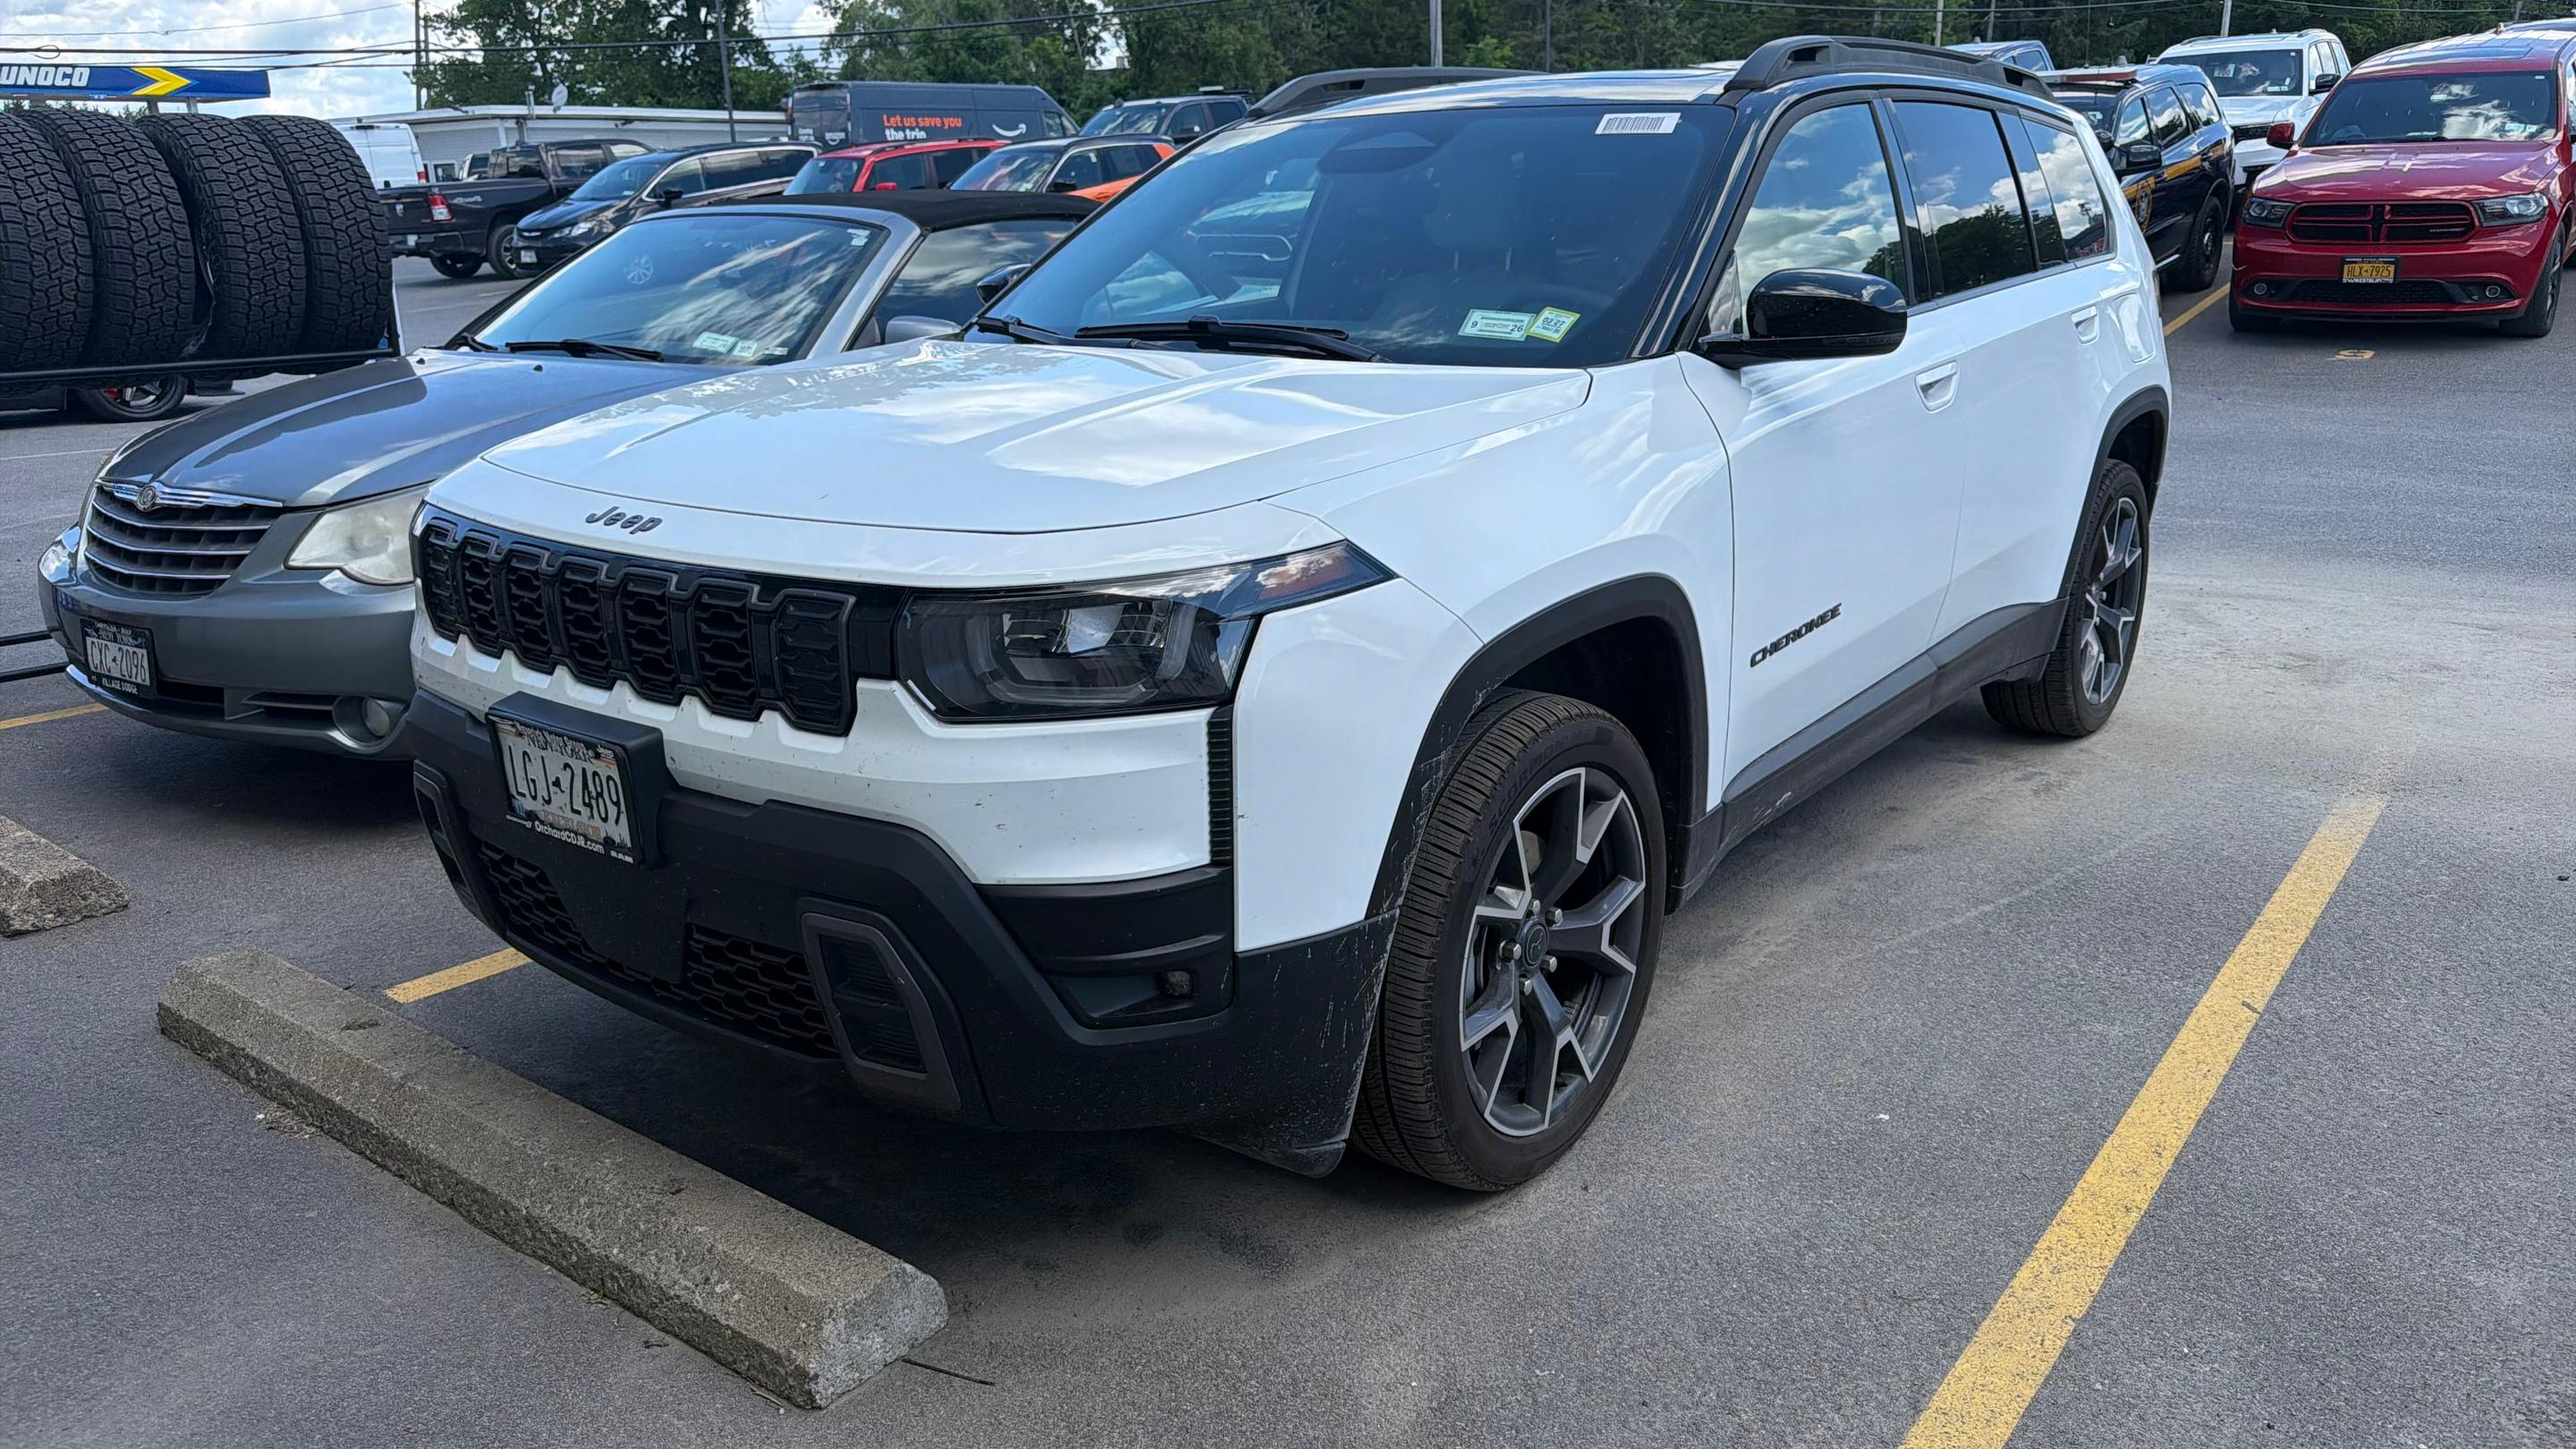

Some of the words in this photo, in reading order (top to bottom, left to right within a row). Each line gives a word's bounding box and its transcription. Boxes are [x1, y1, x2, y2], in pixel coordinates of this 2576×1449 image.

[883, 114, 902, 127] Let
[903, 115, 917, 127] us
[918, 116, 941, 127] save
[943, 116, 962, 129] you
[885, 128, 904, 140] the
[1470, 320, 1479, 329] 9
[1510, 324, 1524, 333] 26
[585, 505, 664, 535] Jeep
[1750, 602, 1843, 668] CHEROKEE
[534, 820, 606, 855] OrchardCDJR.com
